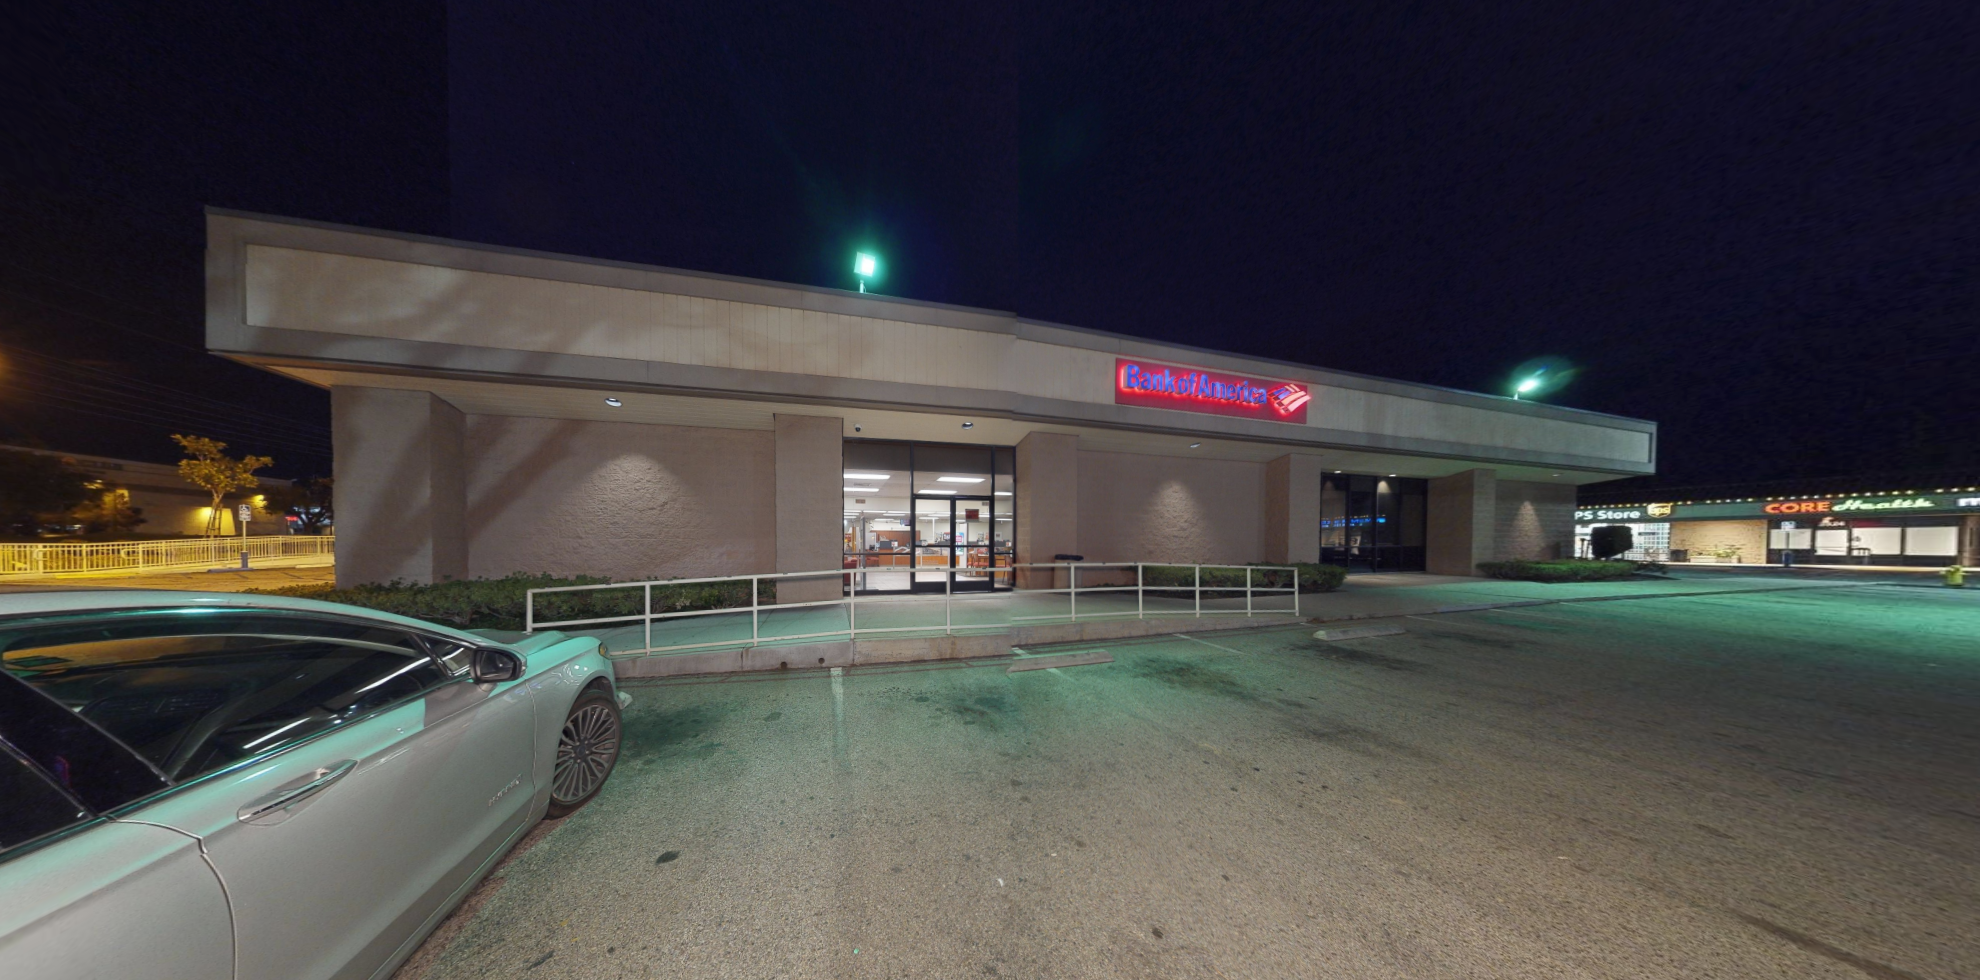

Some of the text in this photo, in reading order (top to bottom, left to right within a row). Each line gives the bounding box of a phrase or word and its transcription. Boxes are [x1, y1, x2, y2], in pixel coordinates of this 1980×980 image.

[1125, 364, 1268, 404] Bank of America
[1765, 498, 1934, 513] CORE Health
[1596, 510, 1641, 519] Store
